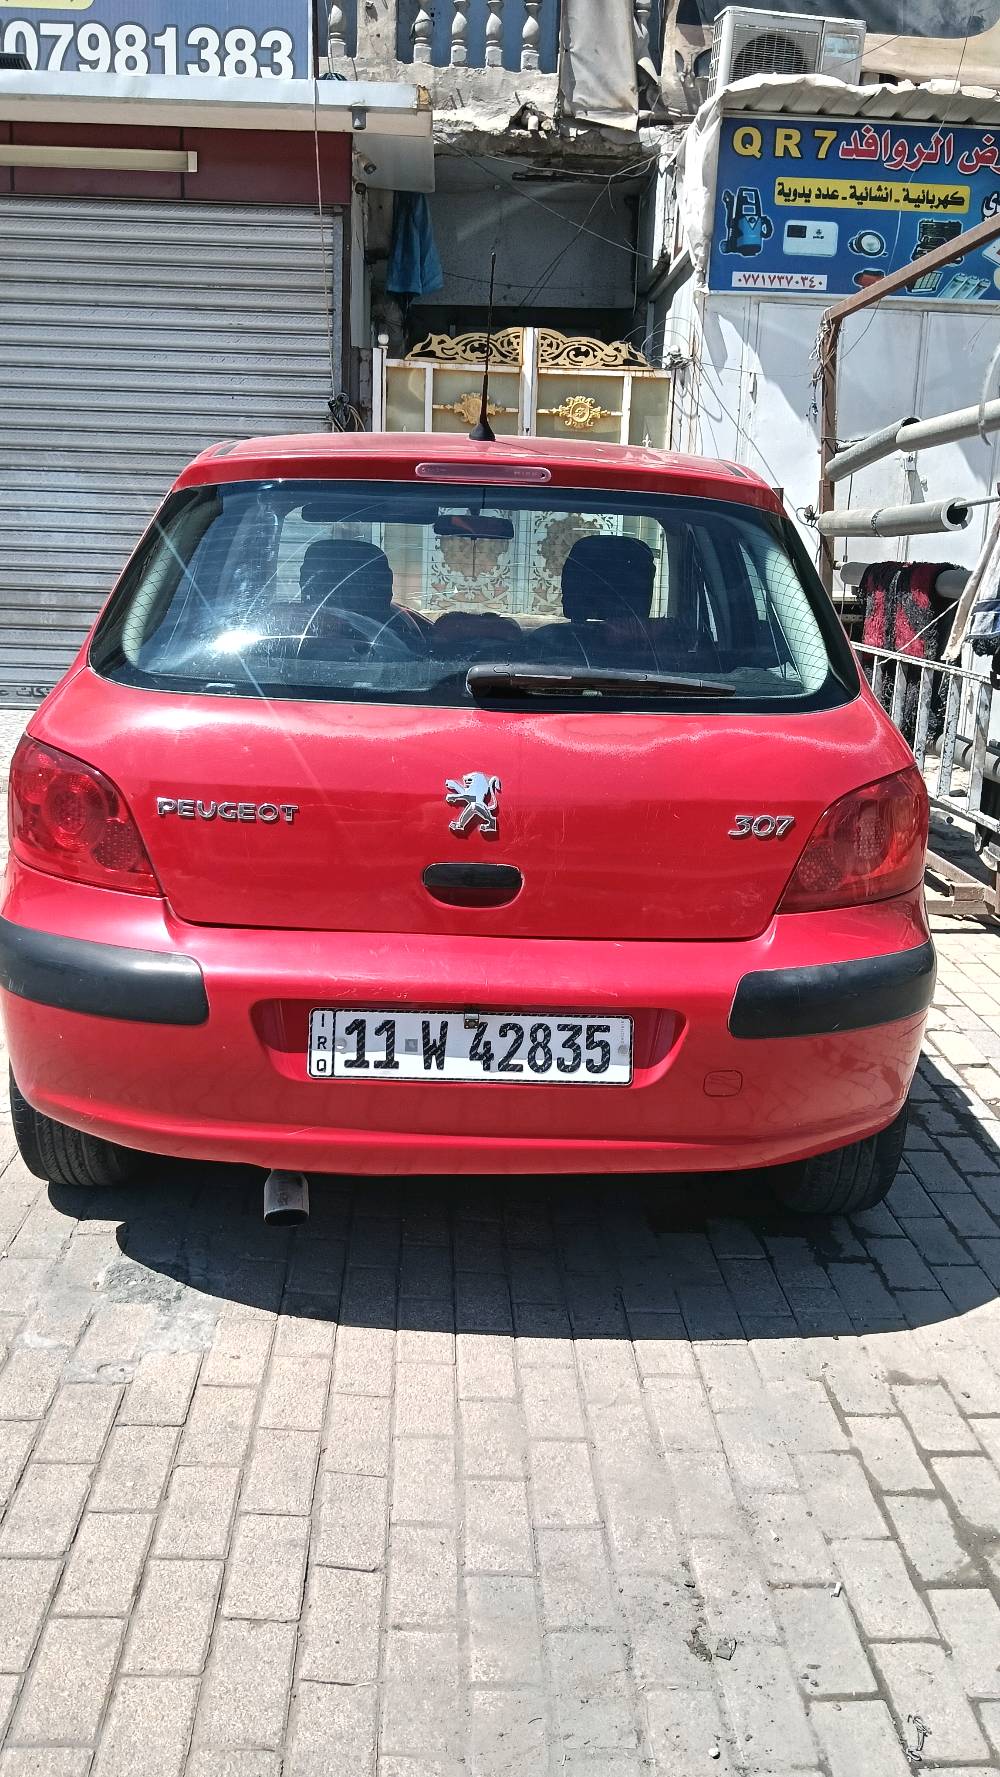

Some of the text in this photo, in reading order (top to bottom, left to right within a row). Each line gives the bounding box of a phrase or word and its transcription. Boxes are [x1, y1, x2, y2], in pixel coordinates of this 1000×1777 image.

[838, 124, 954, 172] الروافد
[777, 182, 812, 203] يدوية
[815, 186, 840, 201] عدد
[902, 187, 966, 210] كهربائية
[156, 797, 299, 823] PEUGEOT
[727, 814, 796, 837] 307
[344, 1018, 400, 1070] 11
[421, 1020, 448, 1070] W
[469, 1021, 611, 1074] 42835
